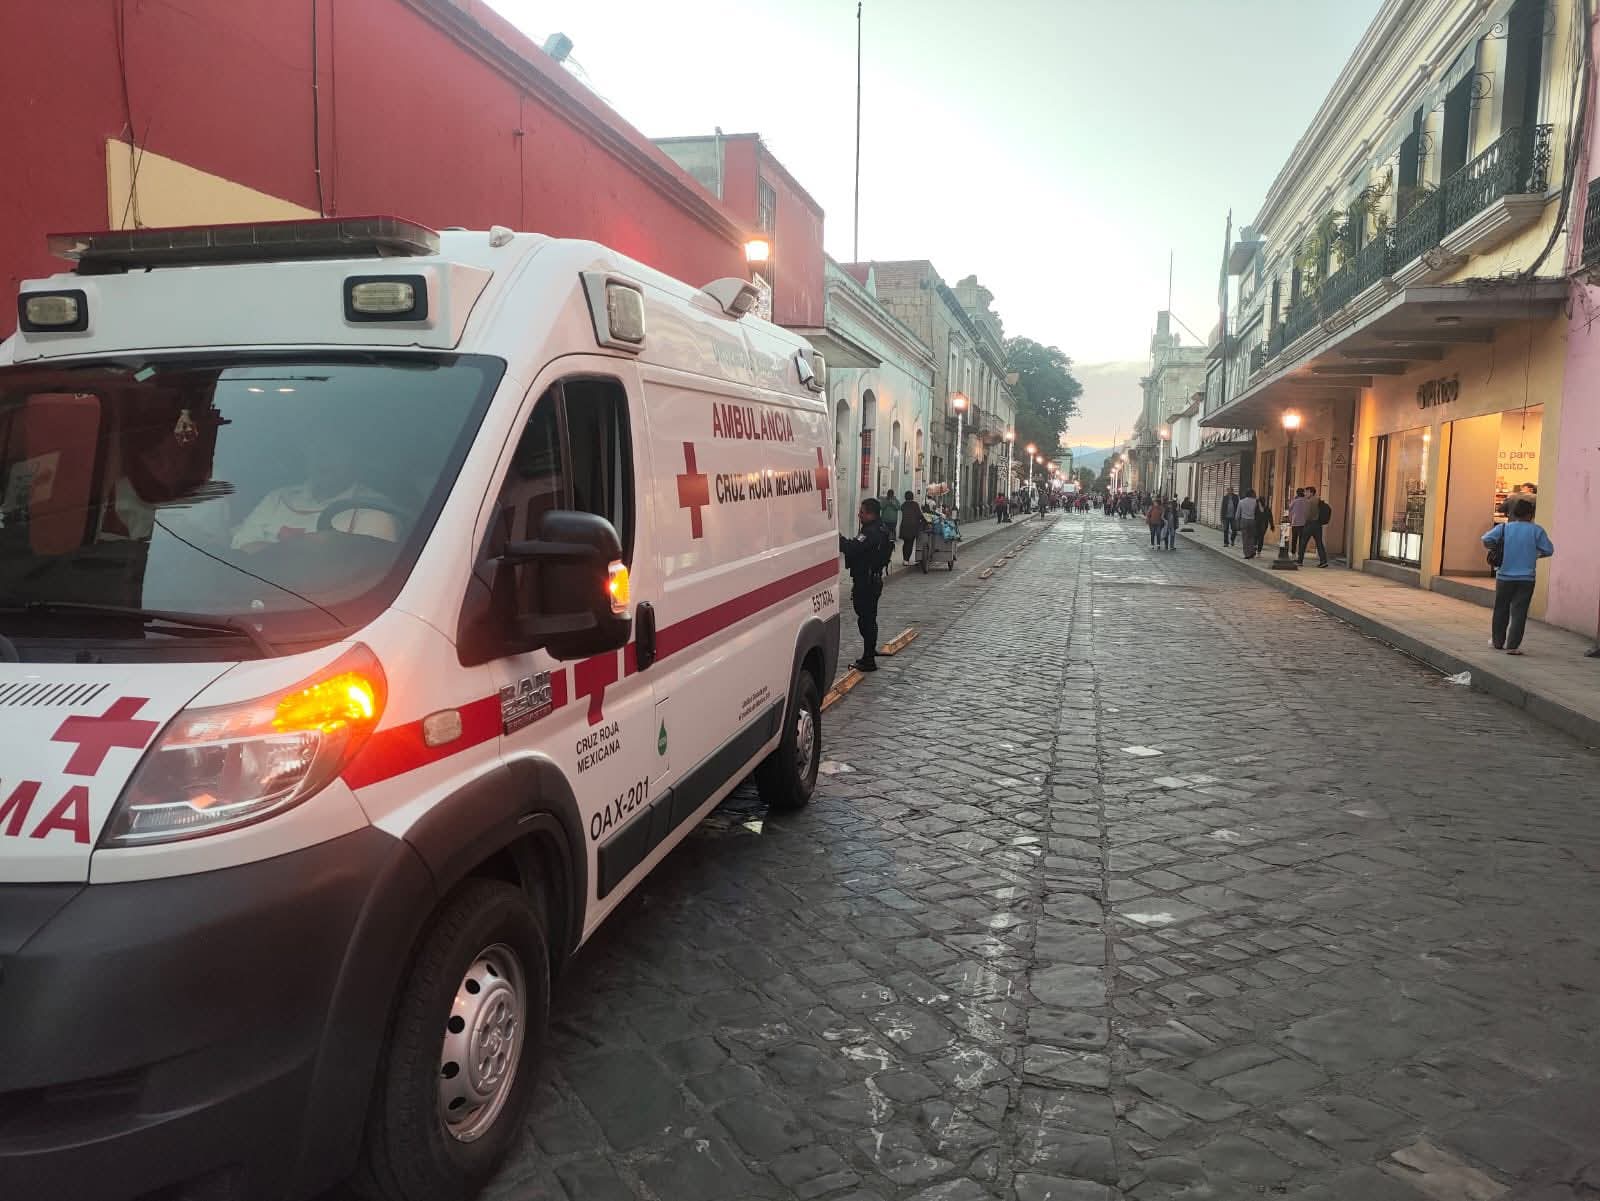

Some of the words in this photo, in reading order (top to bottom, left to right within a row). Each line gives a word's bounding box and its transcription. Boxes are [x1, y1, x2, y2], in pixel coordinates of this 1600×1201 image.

[713, 403, 794, 441] AMBULANCIA
[715, 473, 745, 504] CRUZ
[749, 473, 773, 499] ROJA
[776, 469, 813, 497] MEXICANA
[576, 732, 598, 755] CRUZ
[599, 720, 619, 745] ROJA
[577, 739, 620, 775] MEXICANA
[590, 775, 650, 841] OAX-201
